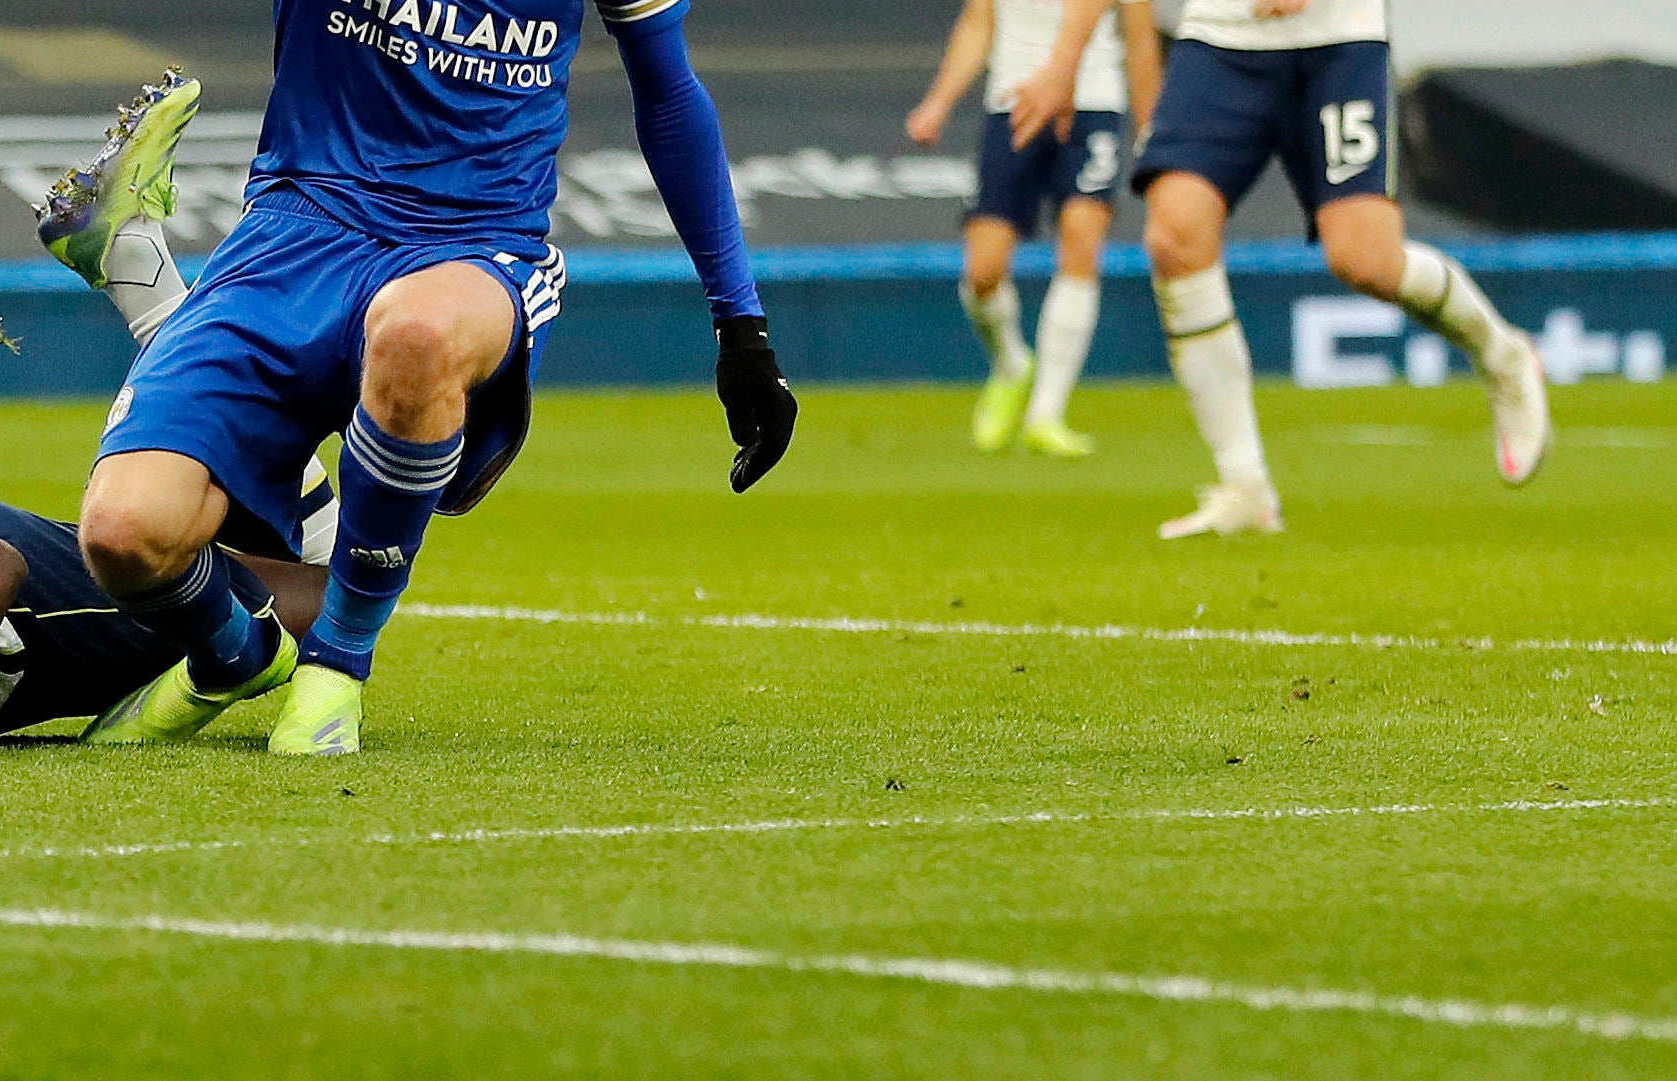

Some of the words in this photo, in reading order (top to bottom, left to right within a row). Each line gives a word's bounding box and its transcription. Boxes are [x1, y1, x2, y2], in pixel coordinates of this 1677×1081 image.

[327, 9, 419, 66] SMILES
[427, 46, 496, 87] WITH
[503, 61, 553, 89] YOU
[1319, 99, 1379, 167] 15
